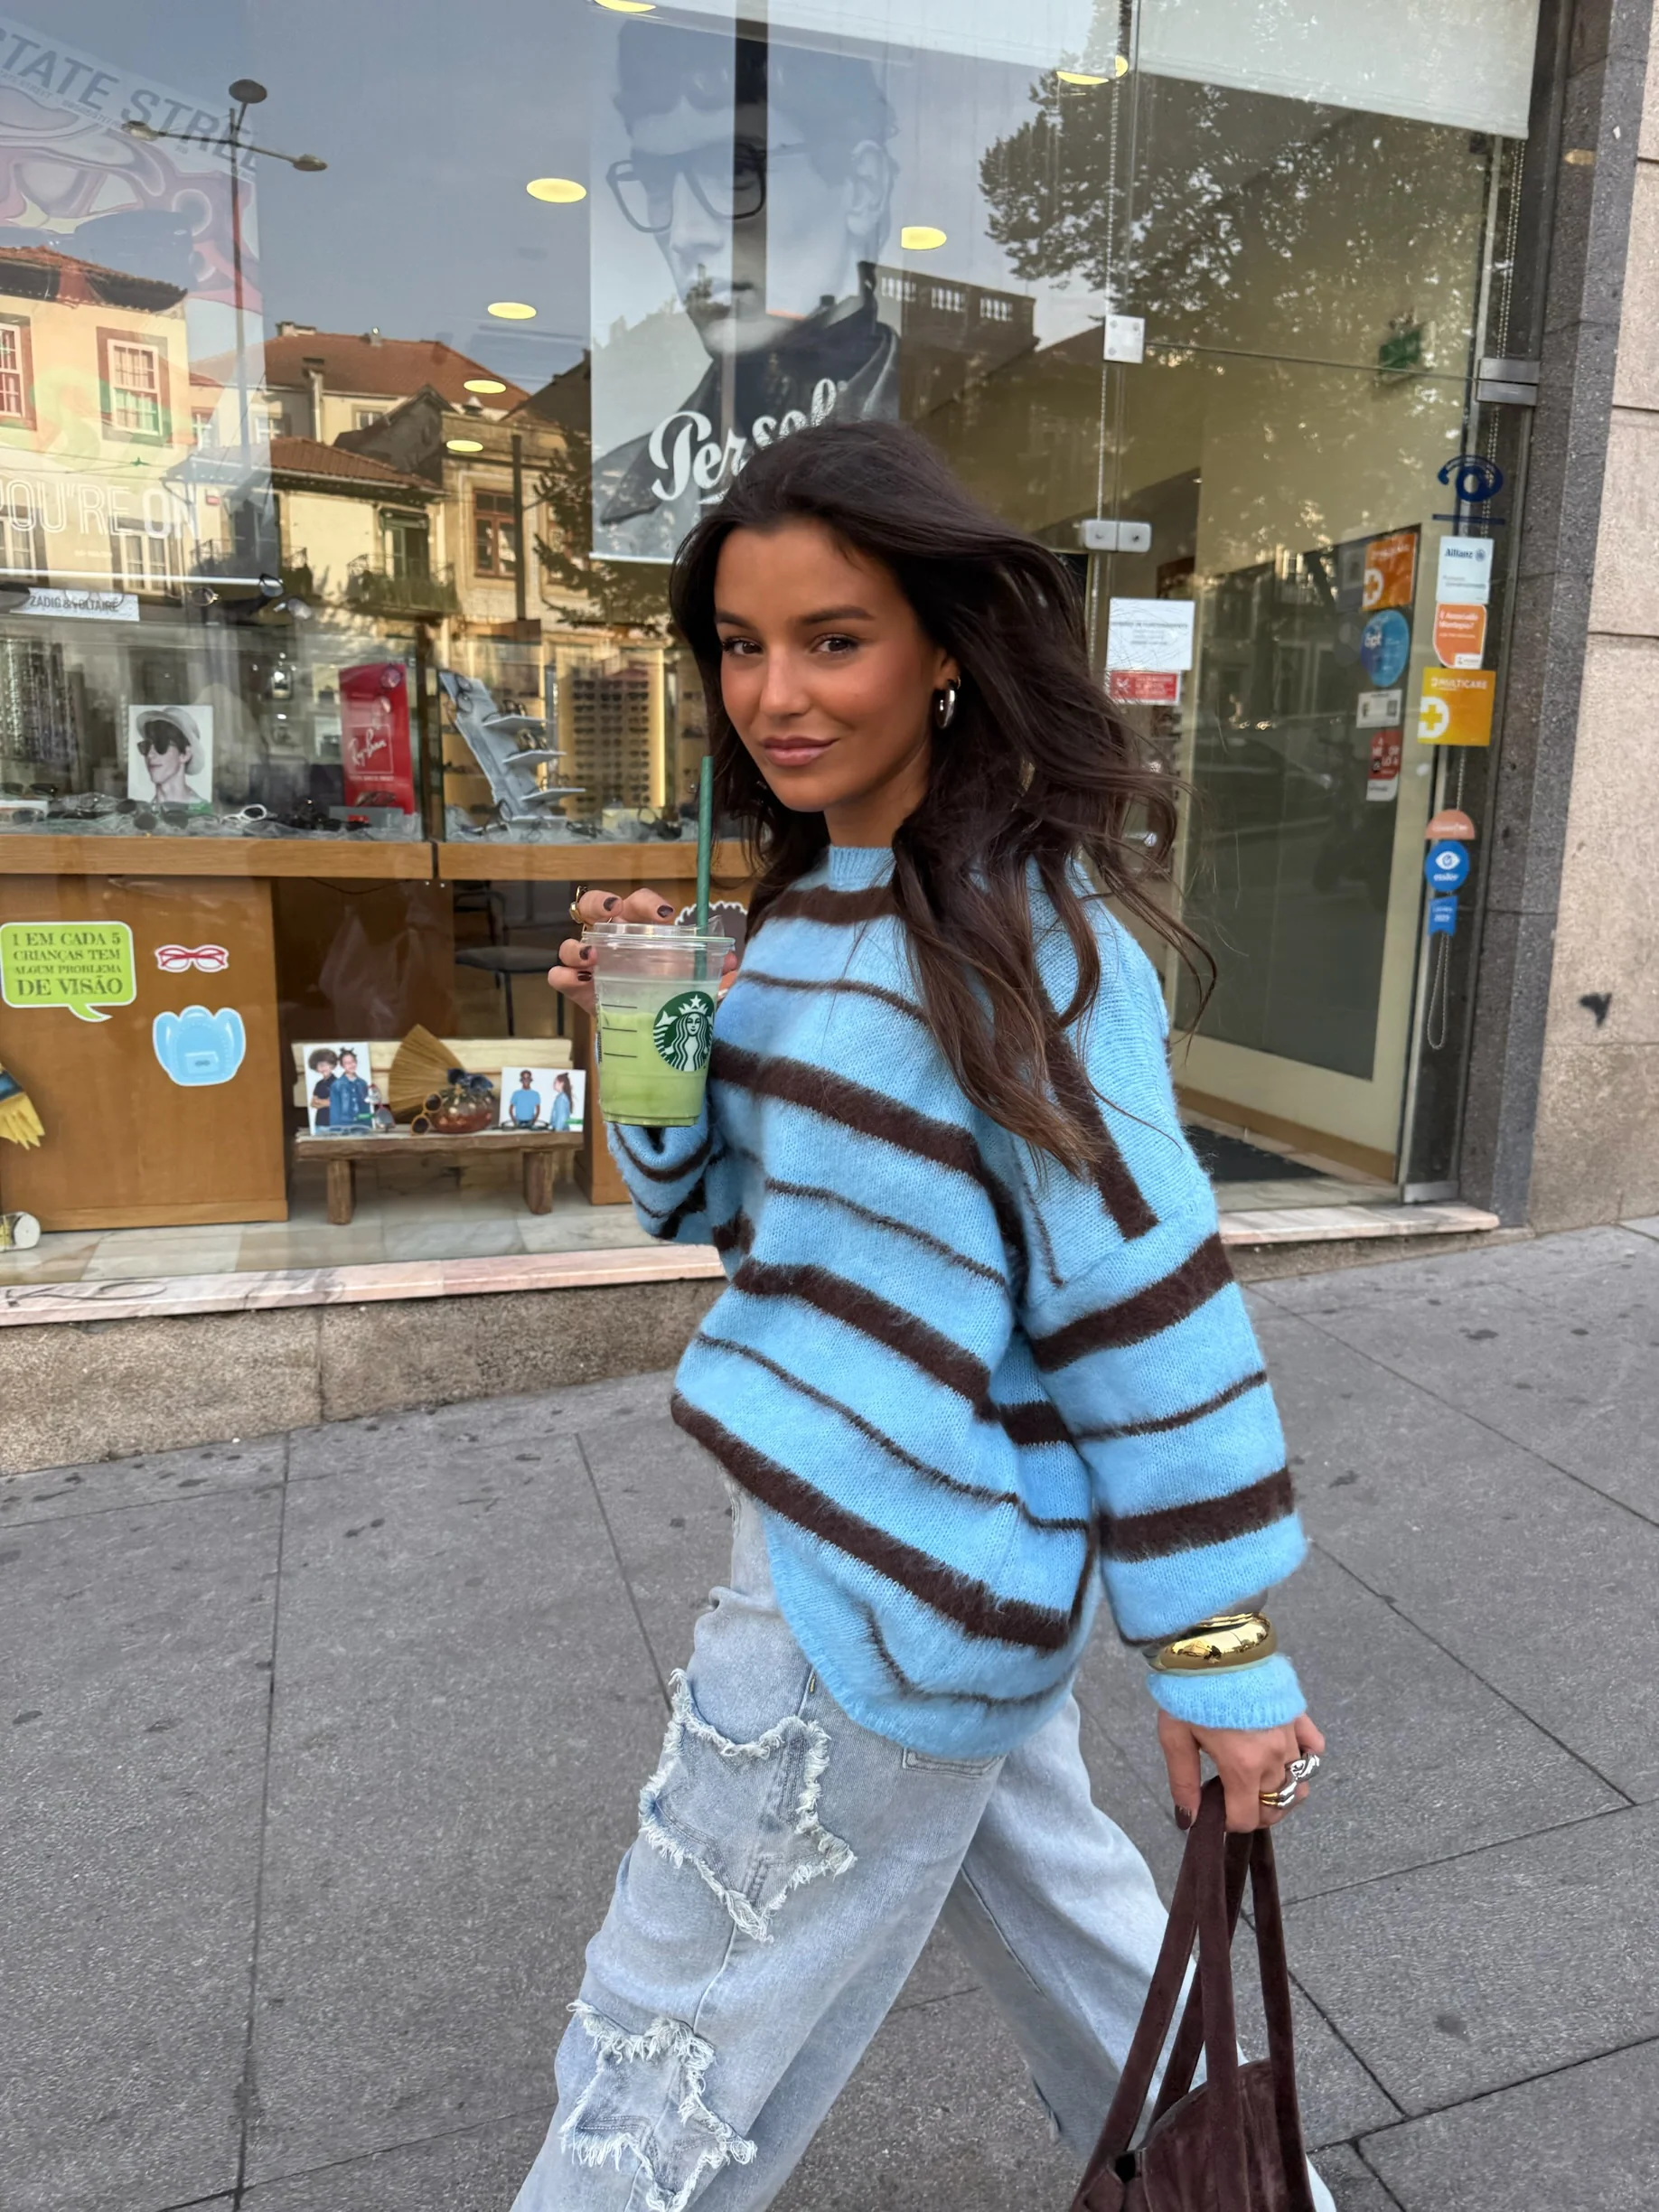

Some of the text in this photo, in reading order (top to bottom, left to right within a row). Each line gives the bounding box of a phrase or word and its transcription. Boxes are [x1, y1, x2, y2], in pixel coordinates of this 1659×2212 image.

[0, 28, 120, 110] TATE
[1444, 548, 1474, 559] Allianz
[12, 932, 121, 946] 1 EM CADA 5
[13, 948, 120, 962] CRIANÇAS TEM
[14, 963, 121, 974] ALGUM PROBLEMA
[16, 974, 123, 996] DE VISÃO
